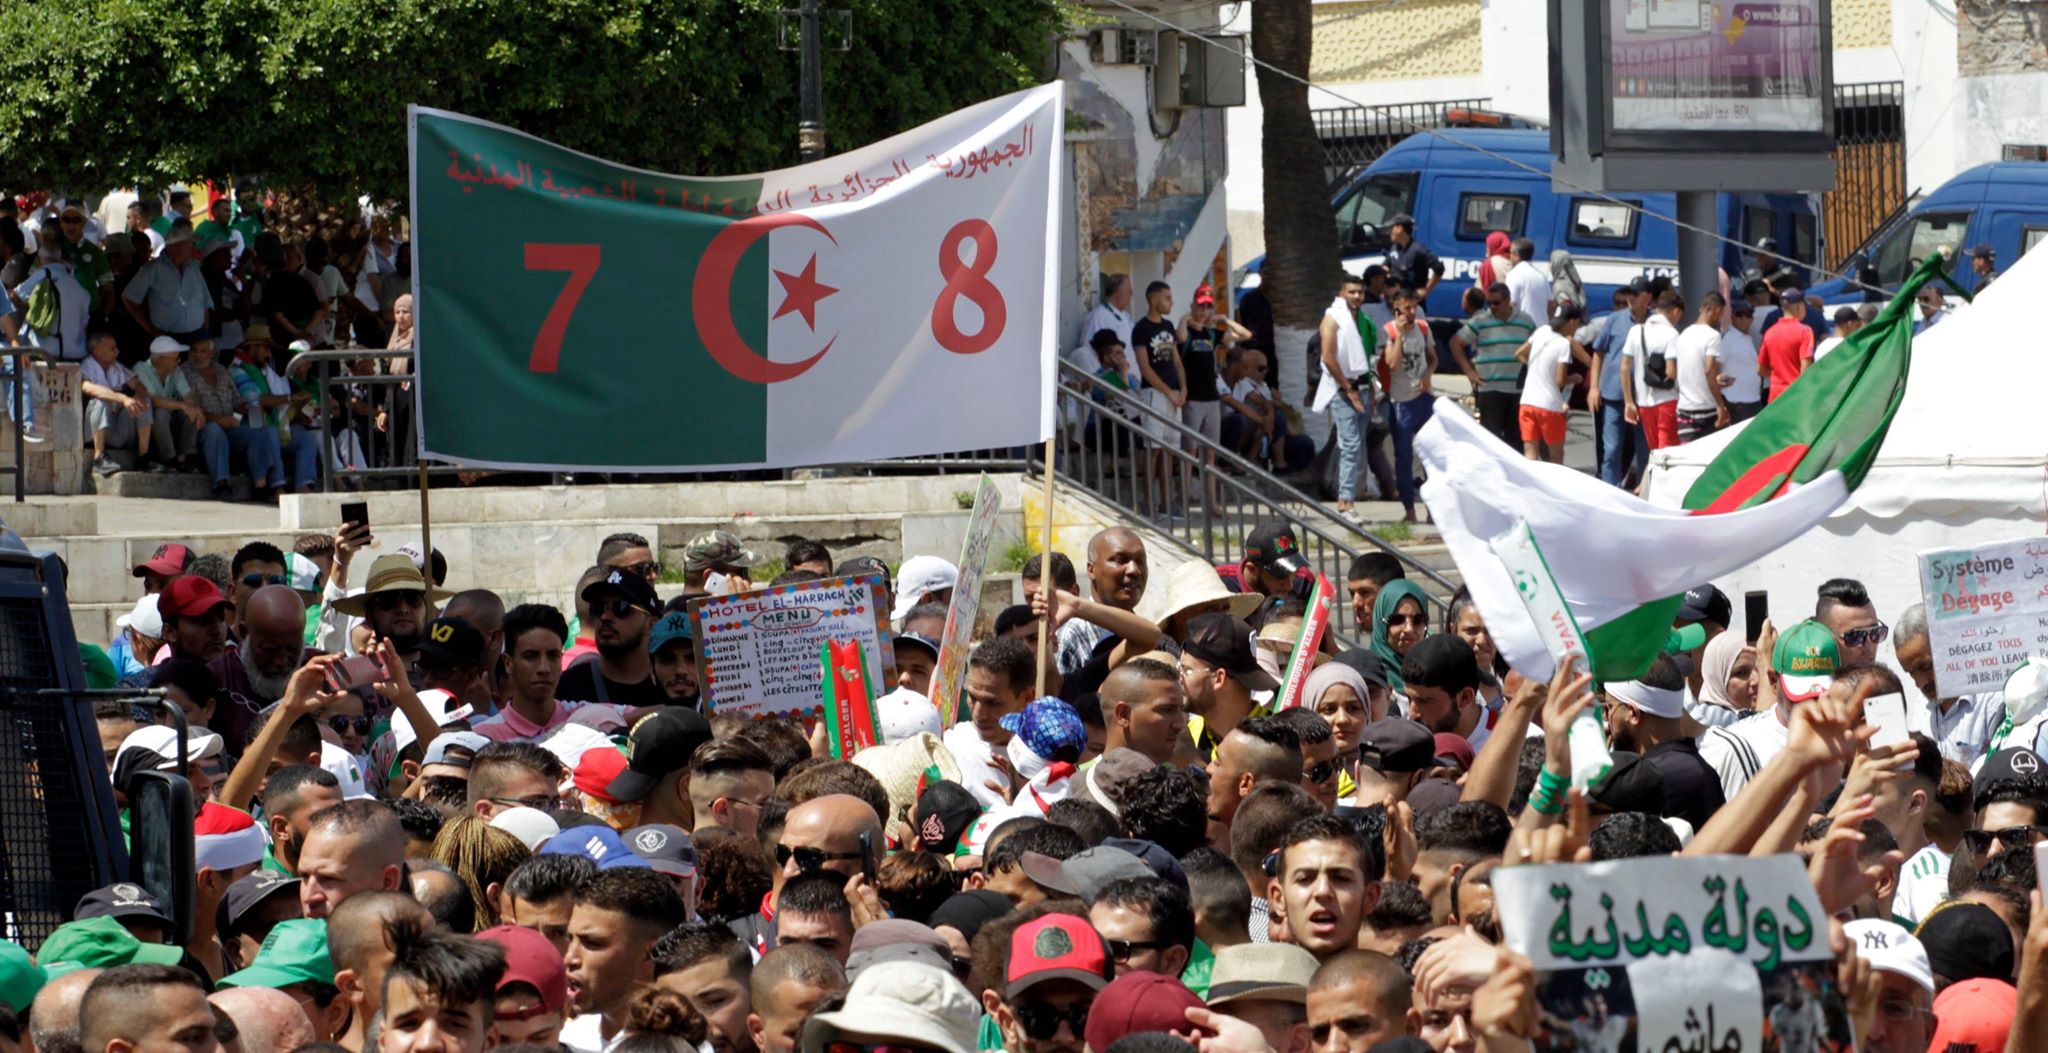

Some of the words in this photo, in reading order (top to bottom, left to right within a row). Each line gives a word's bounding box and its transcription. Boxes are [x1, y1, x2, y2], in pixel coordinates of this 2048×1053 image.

[929, 124, 1034, 179] الجمهورية
[448, 151, 533, 194] المدنية
[523, 243, 601, 374] 7
[931, 218, 1007, 355] 8
[1932, 556, 2015, 584] Système
[709, 602, 769, 619] HOTEL
[773, 588, 846, 609] EL-HARRACH
[762, 608, 812, 624] MENU
[1941, 589, 2014, 615] Dégage
[1551, 610, 1576, 650] VIVA
[1948, 641, 1993, 657] DÉGAGEZ
[1997, 638, 2023, 650] TOUS
[1946, 661, 1961, 673] ALL
[1964, 659, 1977, 669] OF
[1979, 656, 1998, 668] YOU
[1547, 880, 1692, 989] مدنية
[1702, 874, 1813, 971] دولة
[1863, 929, 1889, 949] NY
